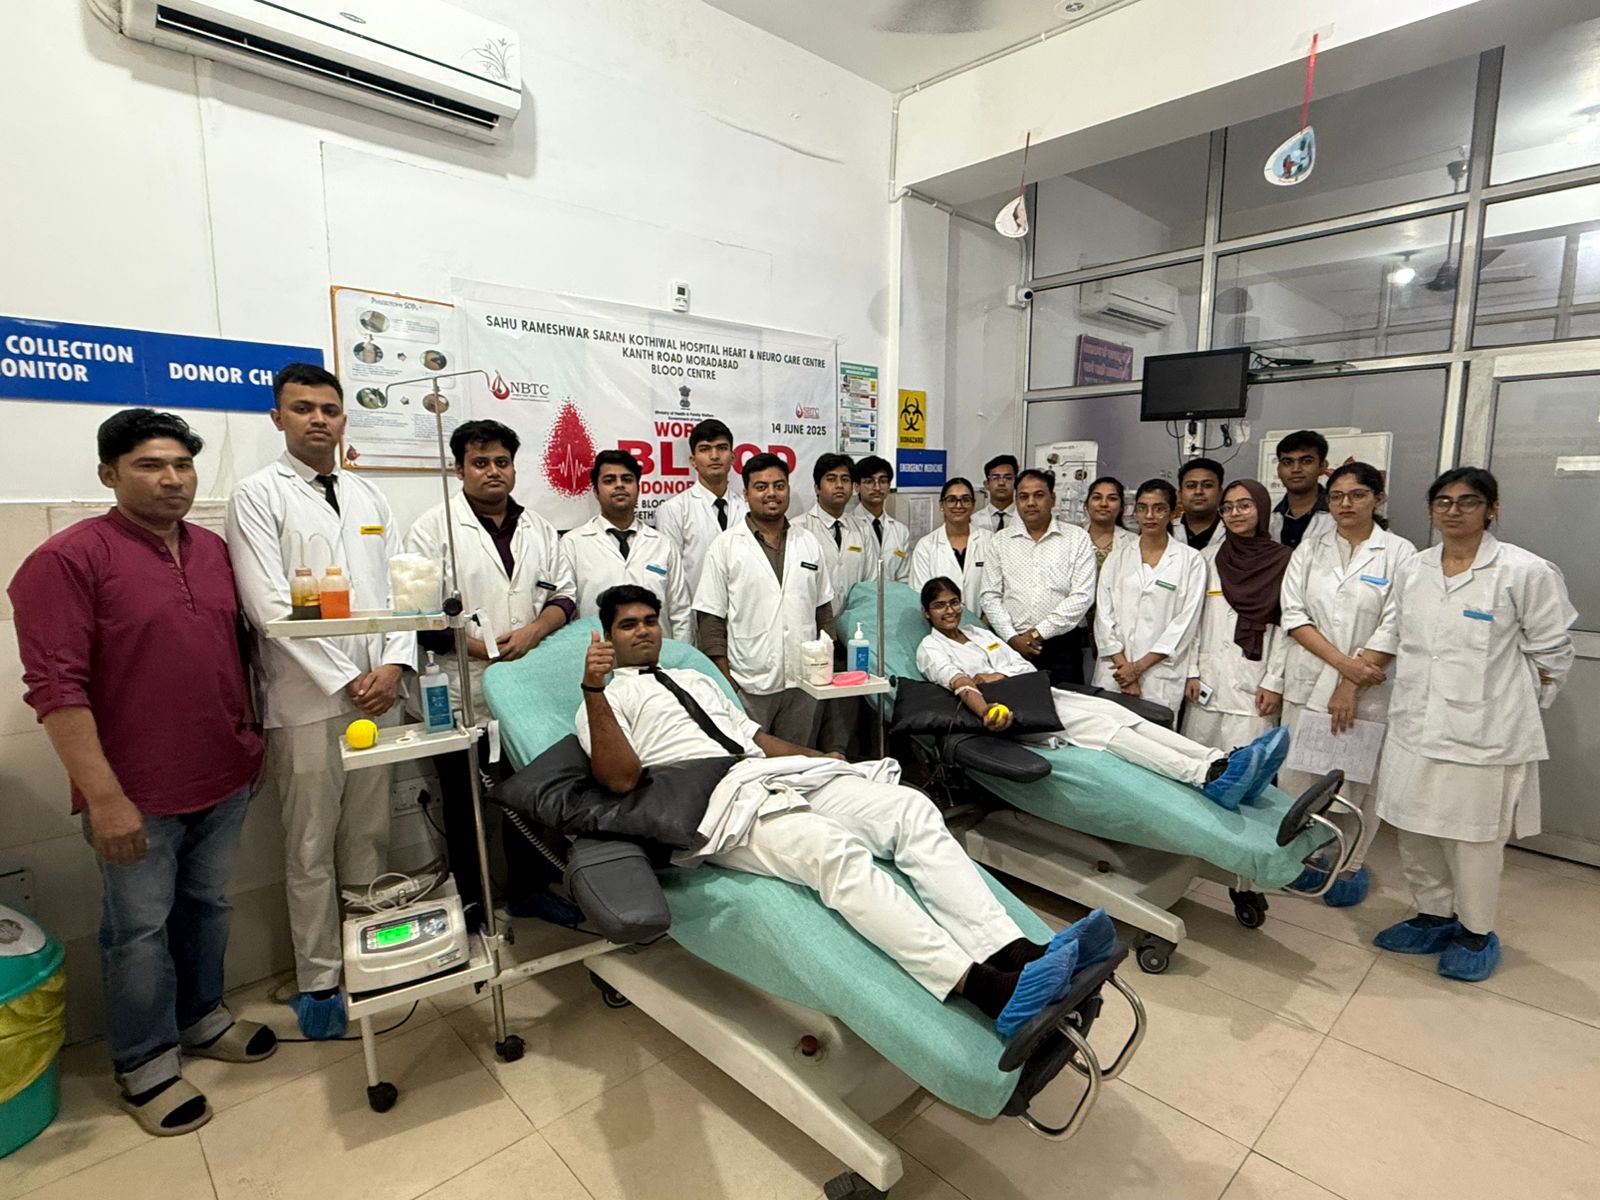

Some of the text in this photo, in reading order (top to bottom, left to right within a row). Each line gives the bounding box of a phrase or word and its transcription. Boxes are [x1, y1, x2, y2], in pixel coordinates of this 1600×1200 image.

[5, 335, 134, 364] COLLECTION
[486, 315, 826, 368] SAHU RAMESHWAR SARAN KOTHIWAL HOSPITAL HEART & NEURO CARE CENTRE
[0, 358, 89, 382] ONITOR
[622, 347, 739, 370] KANTH ROAD MORADABAD
[169, 362, 244, 385] DONOR
[651, 364, 716, 380] BLOOD CENTRE
[510, 381, 550, 396] NBTC
[771, 423, 827, 436] 14 JUNE 2025
